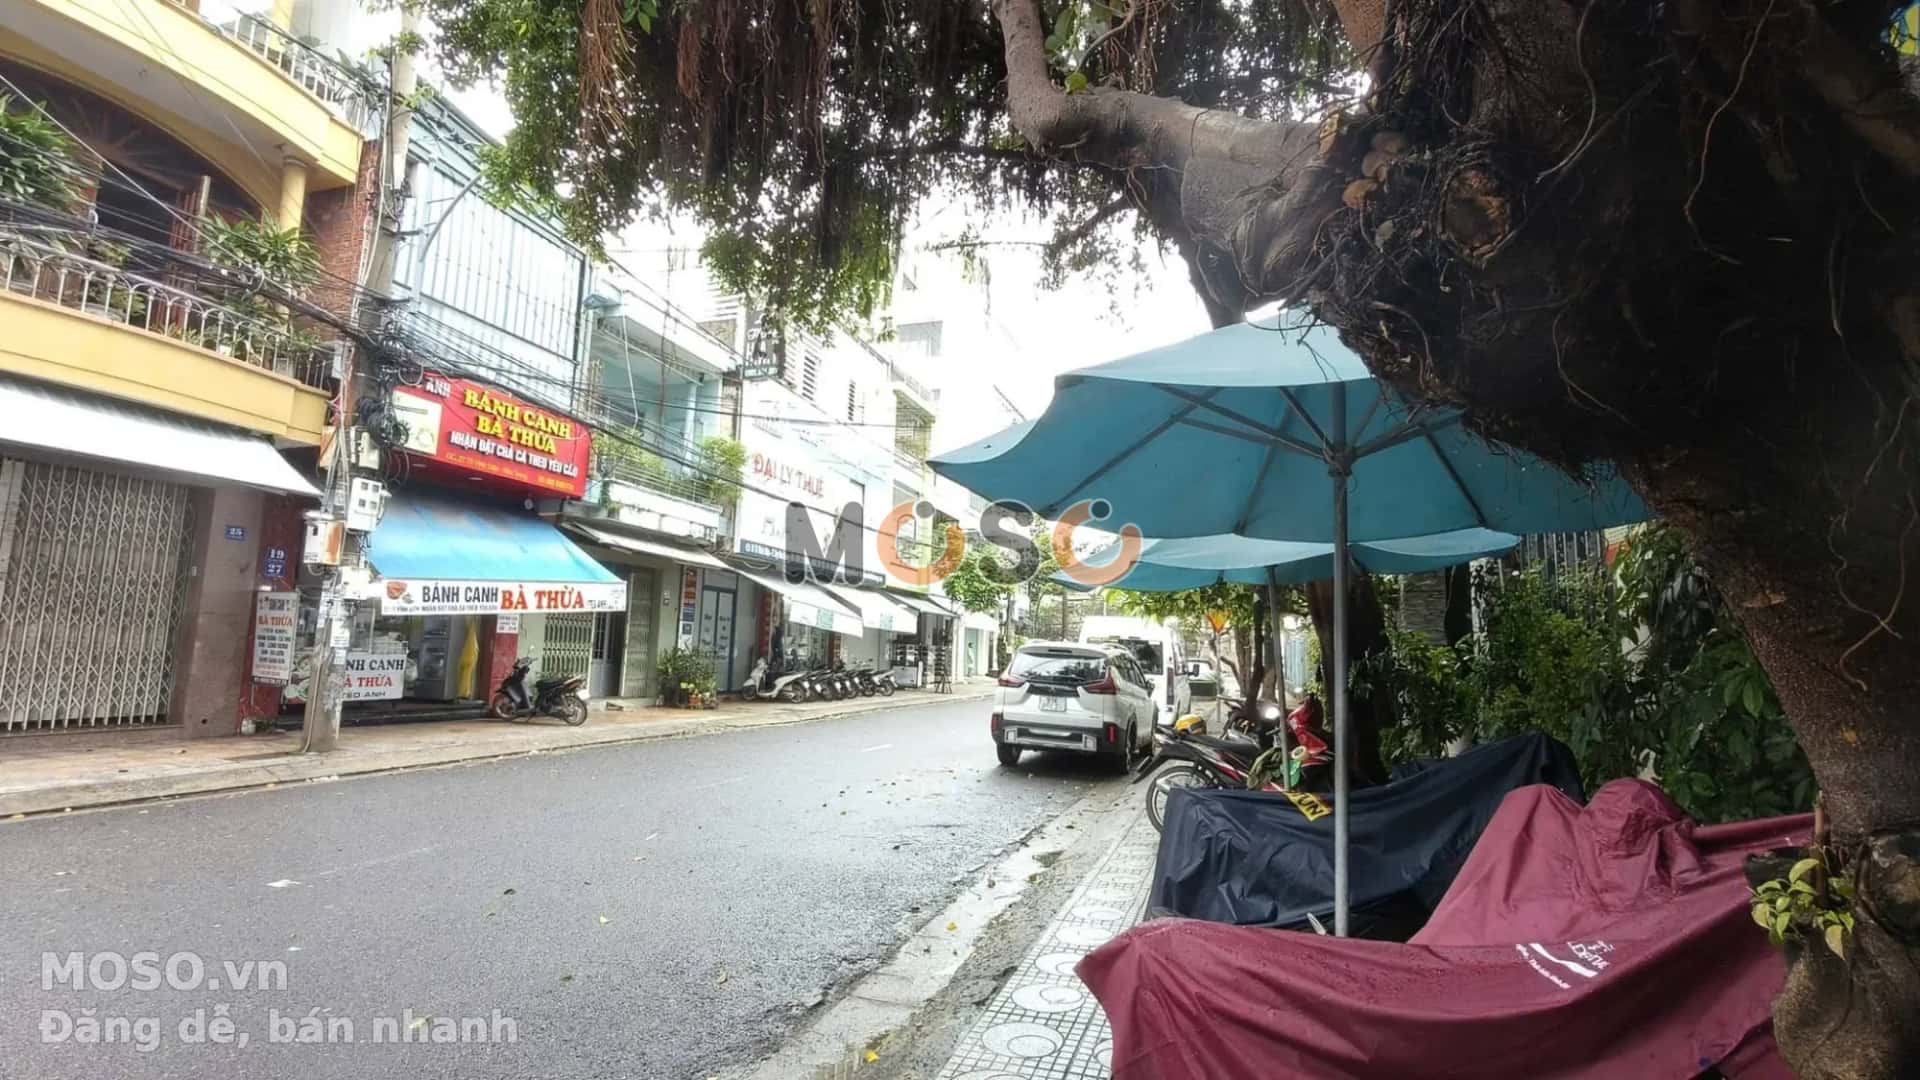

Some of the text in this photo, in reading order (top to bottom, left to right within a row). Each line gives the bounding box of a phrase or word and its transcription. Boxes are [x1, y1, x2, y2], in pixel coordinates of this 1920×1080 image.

[523, 411, 572, 439] CANH
[270, 548, 285, 560] 19
[422, 582, 460, 603] BÁNH
[464, 586, 499, 603] CANH
[500, 584, 528, 610] BÀ
[534, 585, 585, 609] THỪA
[345, 658, 405, 671] NH CANH
[357, 673, 392, 687] THỪA
